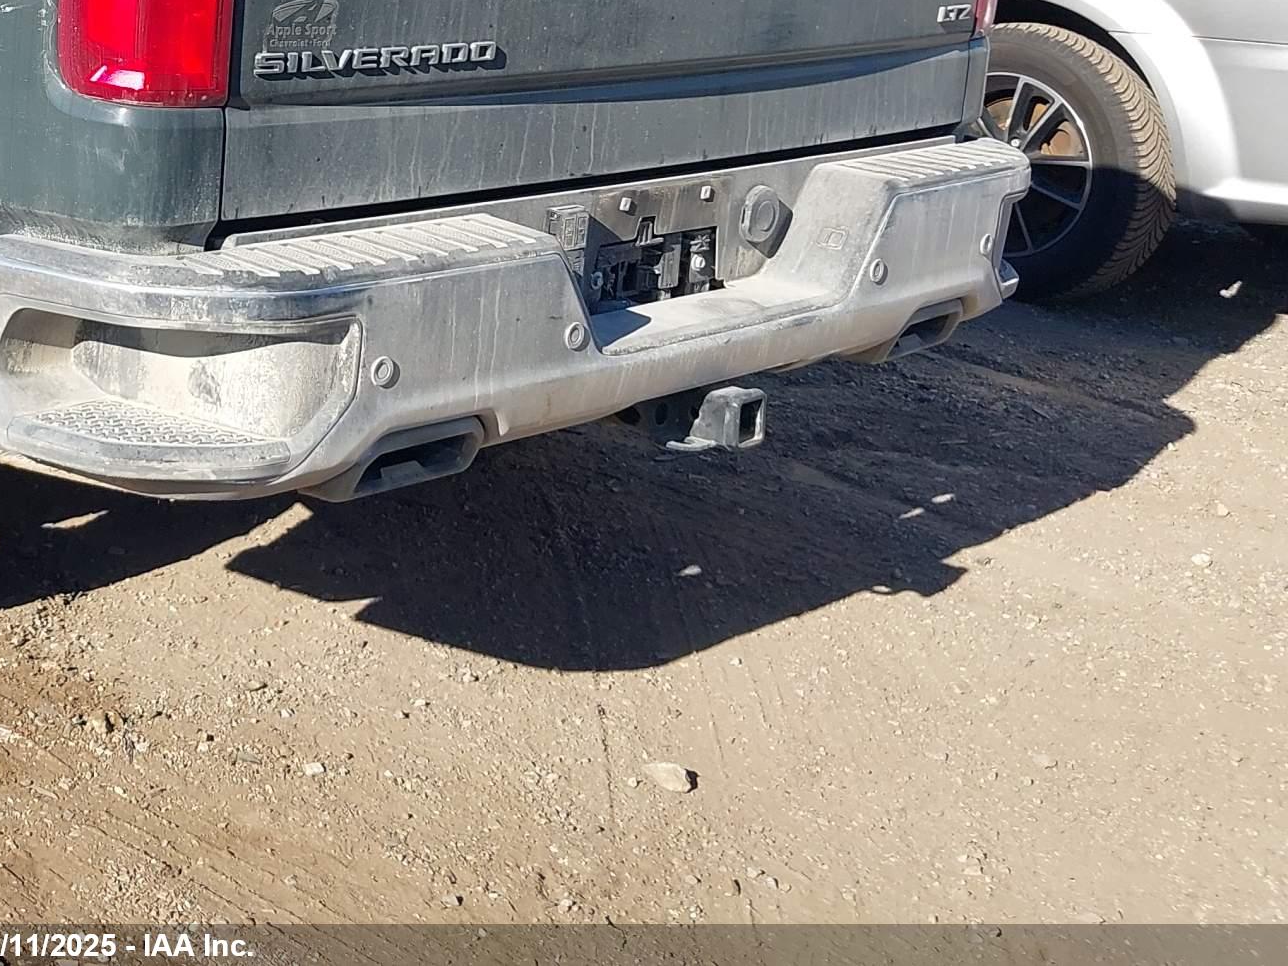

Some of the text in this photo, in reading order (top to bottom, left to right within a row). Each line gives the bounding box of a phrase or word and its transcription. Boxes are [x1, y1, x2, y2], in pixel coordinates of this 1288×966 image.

[937, 4, 972, 22] LTZ
[266, 22, 337, 39] Apple Sport
[253, 41, 498, 77] SILVERADO
